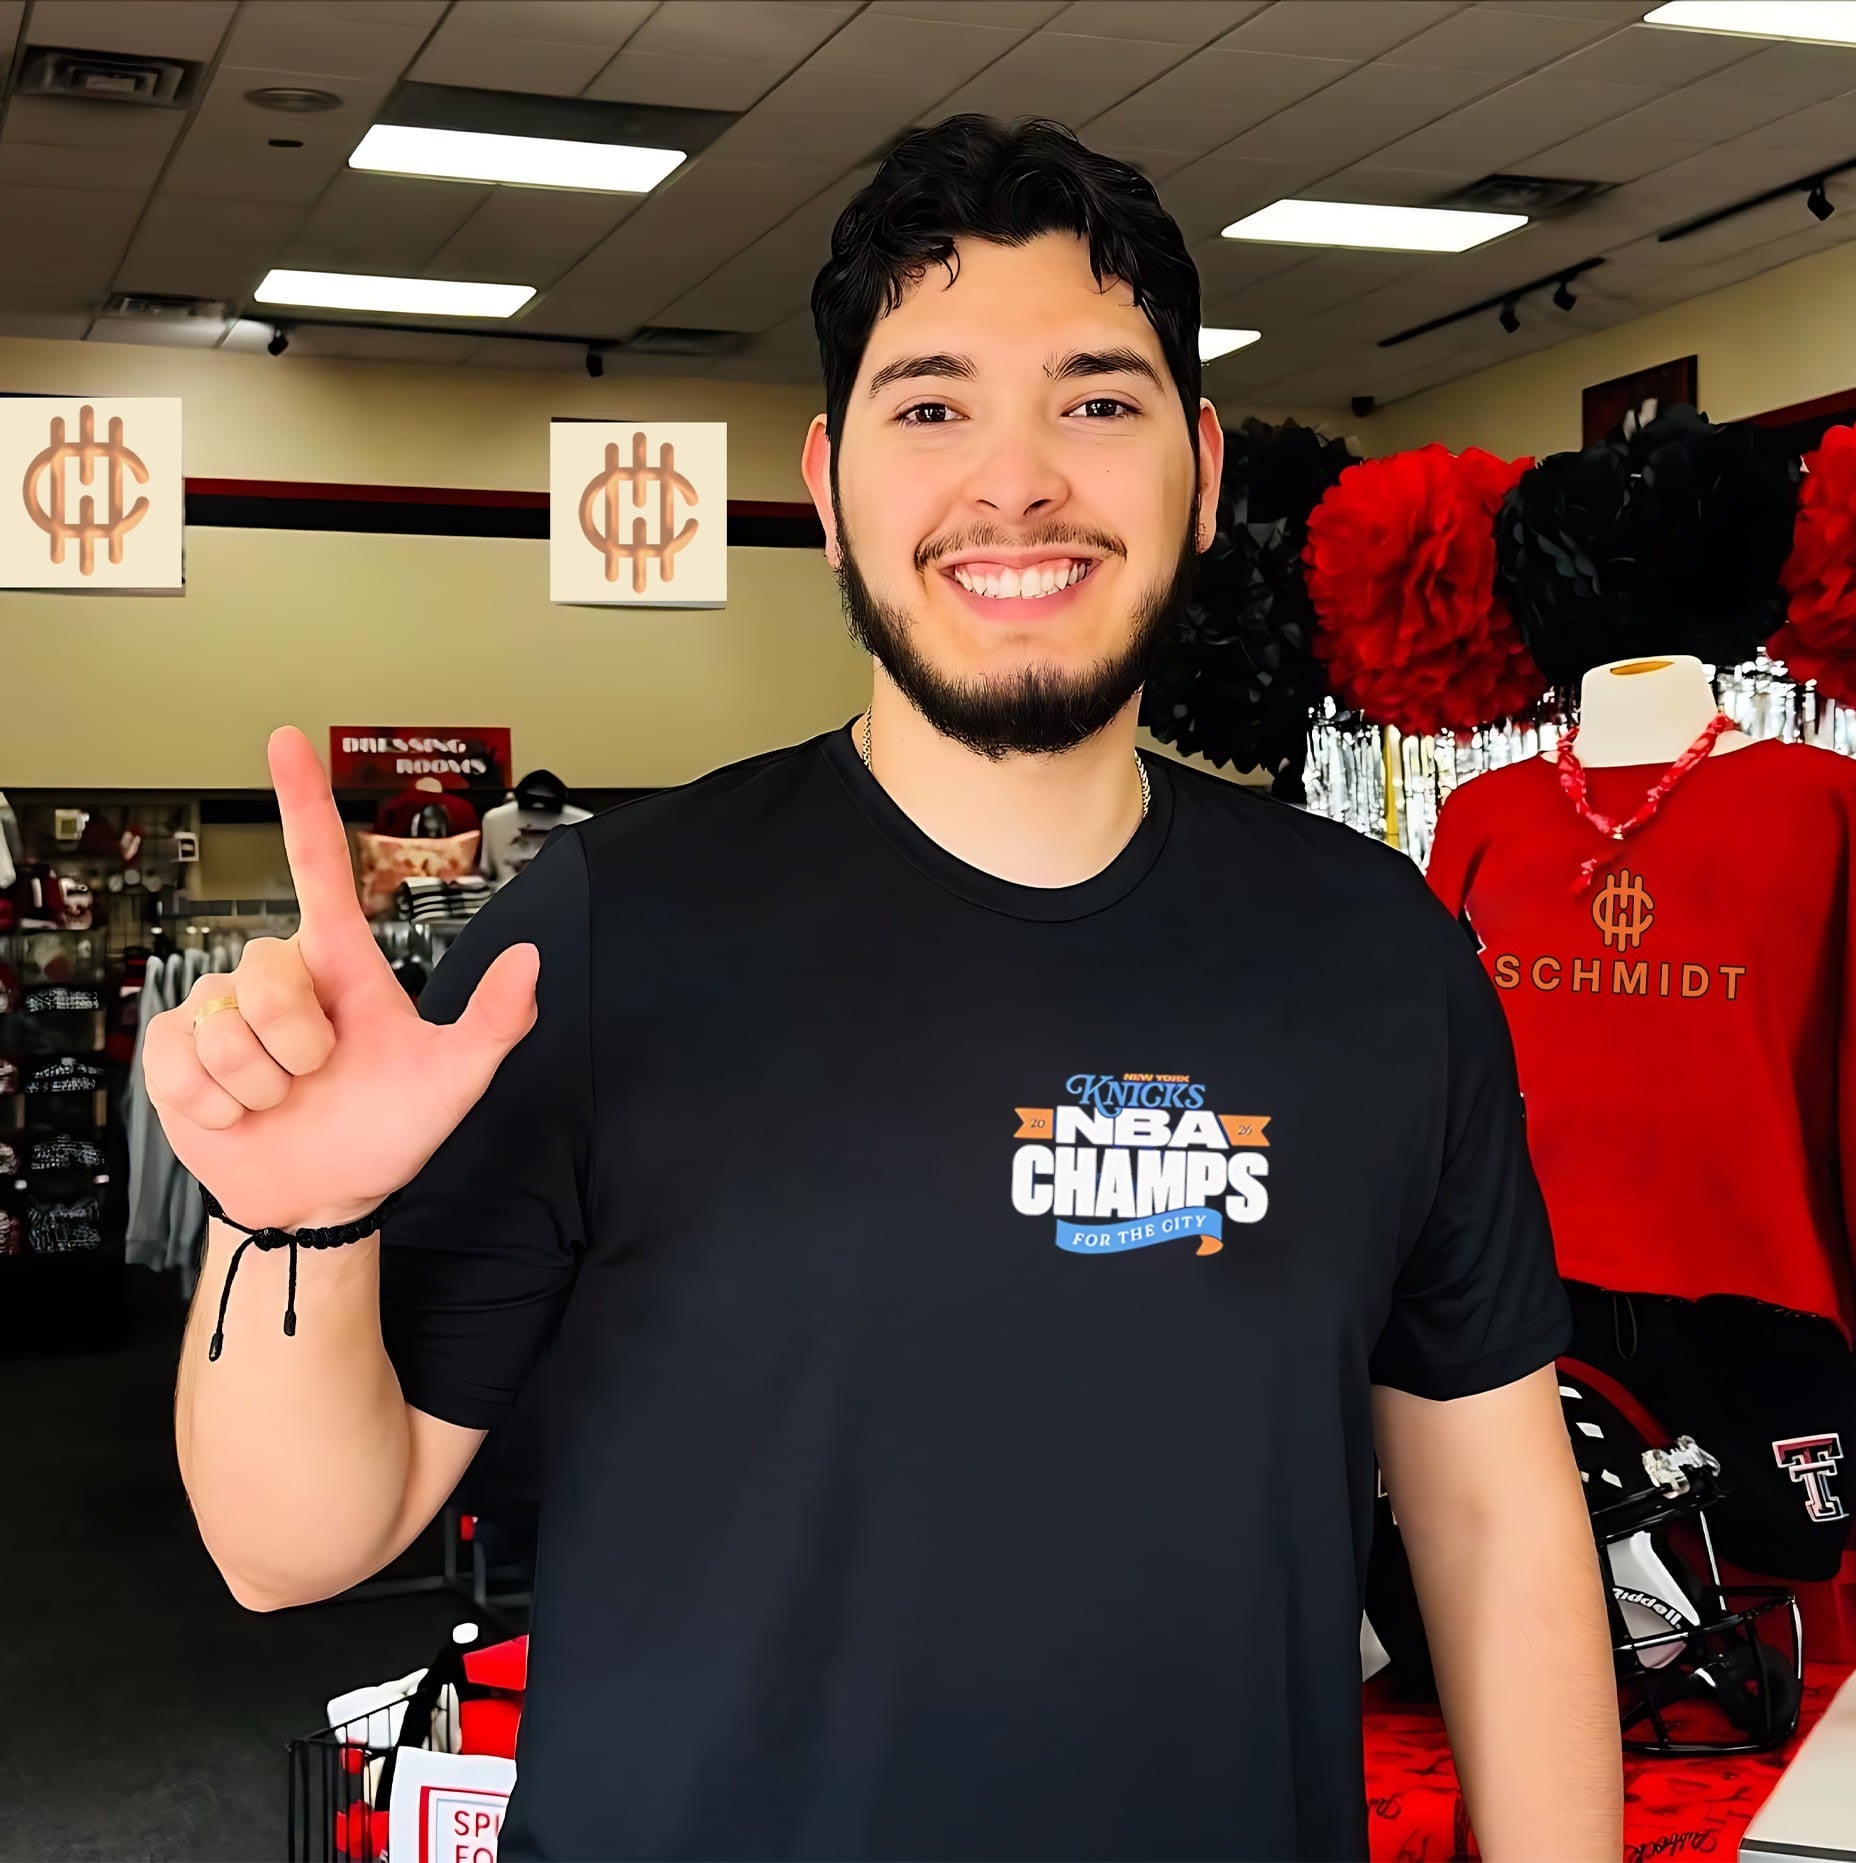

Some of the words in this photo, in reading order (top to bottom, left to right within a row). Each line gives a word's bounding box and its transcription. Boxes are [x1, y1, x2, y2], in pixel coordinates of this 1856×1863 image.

[396, 758, 487, 775] ROOMS
[1494, 953, 1747, 1000] SCHMIDT
[1065, 1073, 1206, 1119] KNICKS
[1123, 1073, 1154, 1082] NEW
[1155, 1074, 1190, 1083] YORK
[1030, 1117, 1046, 1129] 20
[1055, 1105, 1230, 1150] NBA
[1011, 1144, 1269, 1224] CHAMPS
[1072, 1232, 1111, 1247] FOR
[1117, 1224, 1155, 1245] THE
[1161, 1213, 1207, 1233] CITY
